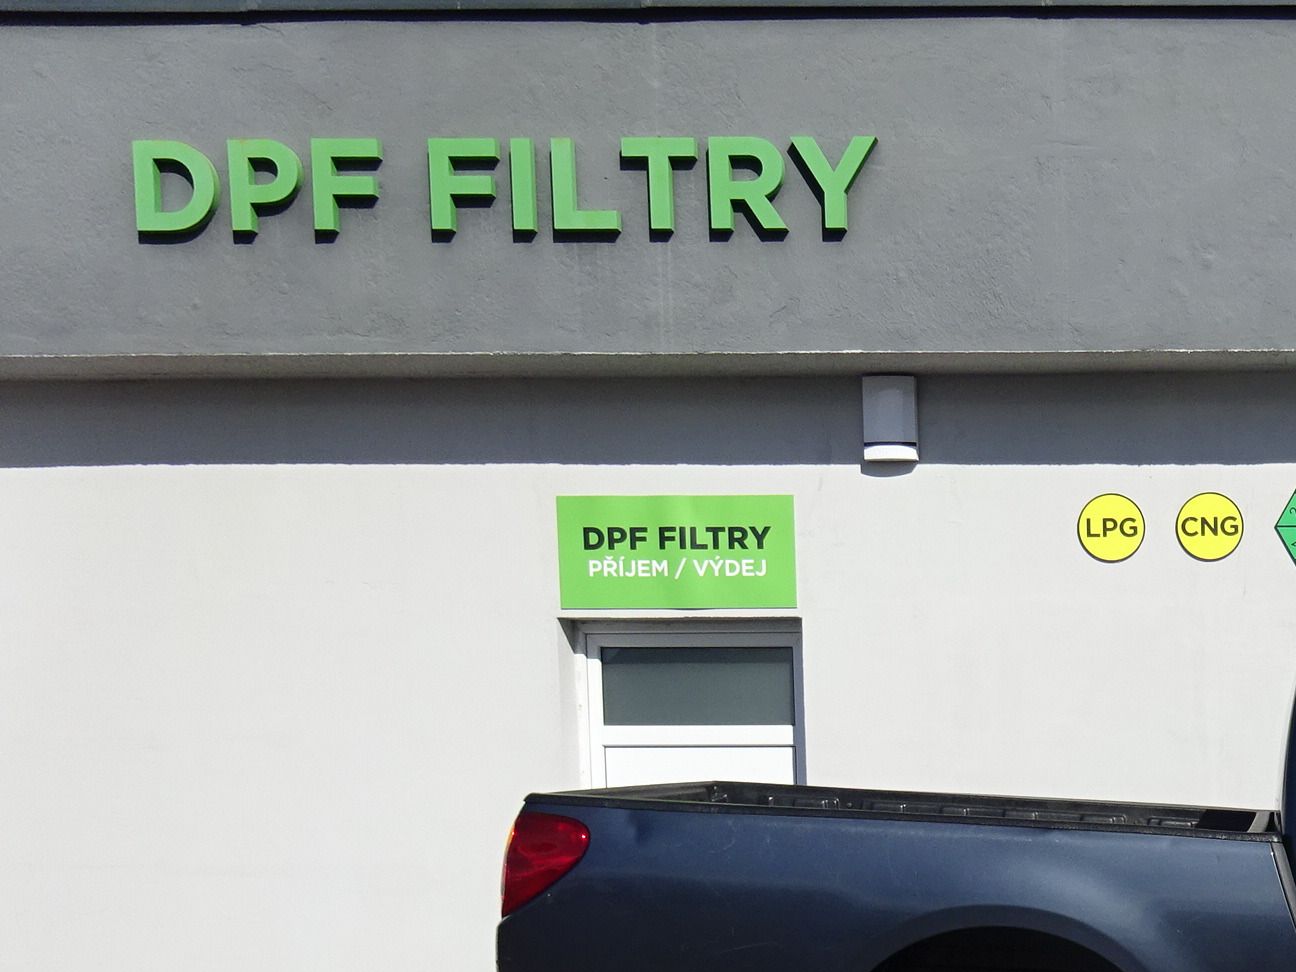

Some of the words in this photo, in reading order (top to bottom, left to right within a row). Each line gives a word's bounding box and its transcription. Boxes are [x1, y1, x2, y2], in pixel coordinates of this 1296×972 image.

[132, 137, 384, 238] DPF
[427, 135, 878, 238] FILTRY
[582, 526, 648, 551] DPF
[658, 525, 771, 550] FILTRY
[1085, 516, 1138, 538] LPG
[1180, 515, 1239, 537] CNG
[588, 555, 669, 577] PŘÍJEM
[673, 557, 687, 580] /
[692, 555, 767, 577] VÝDEJ
